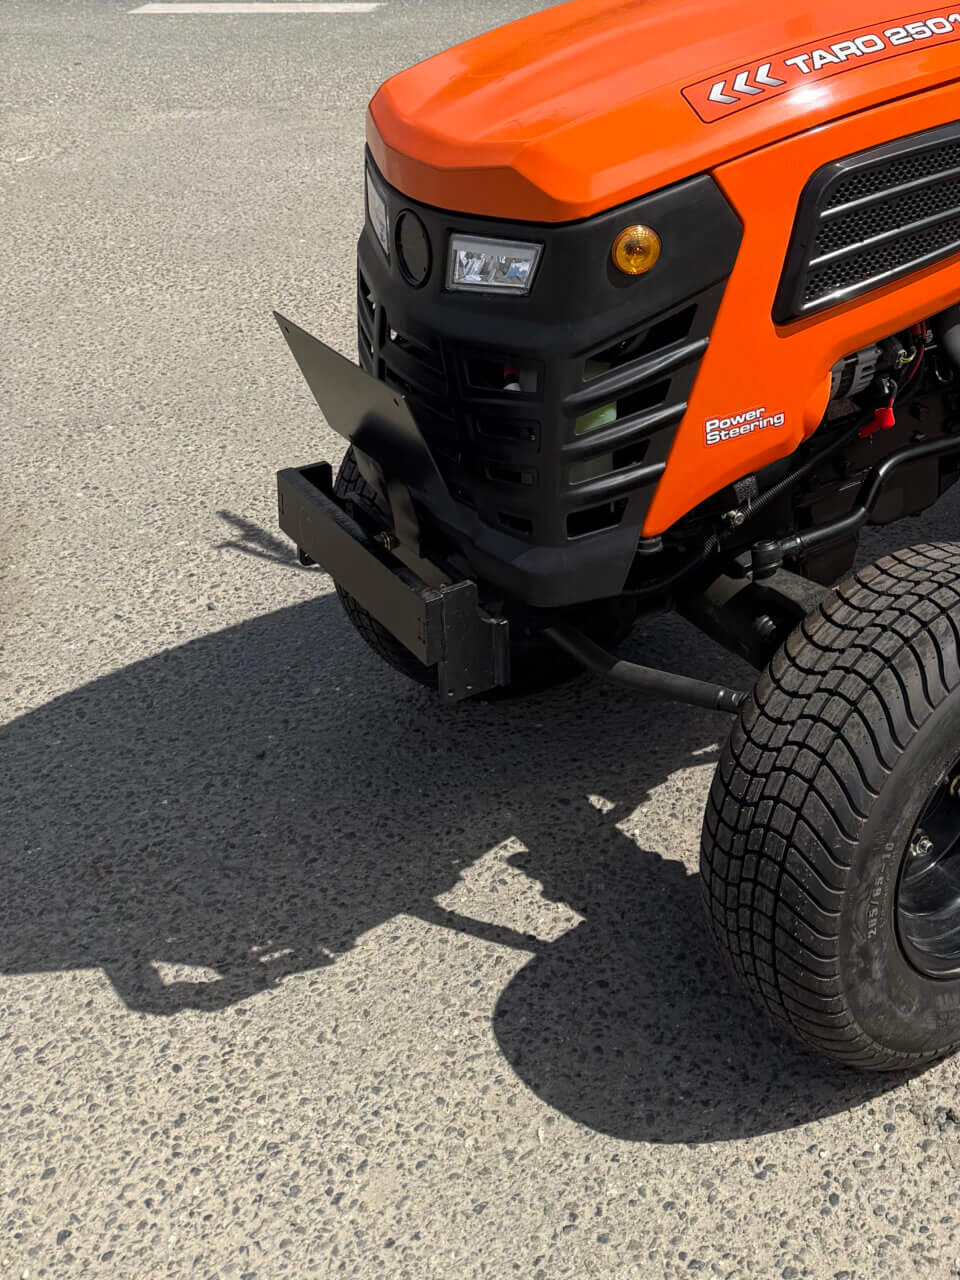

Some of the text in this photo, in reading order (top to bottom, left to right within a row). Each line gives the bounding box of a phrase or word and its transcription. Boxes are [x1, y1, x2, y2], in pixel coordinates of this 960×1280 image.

[785, 32, 886, 75] TARO
[705, 407, 766, 433] Power
[705, 413, 785, 445] Steering
